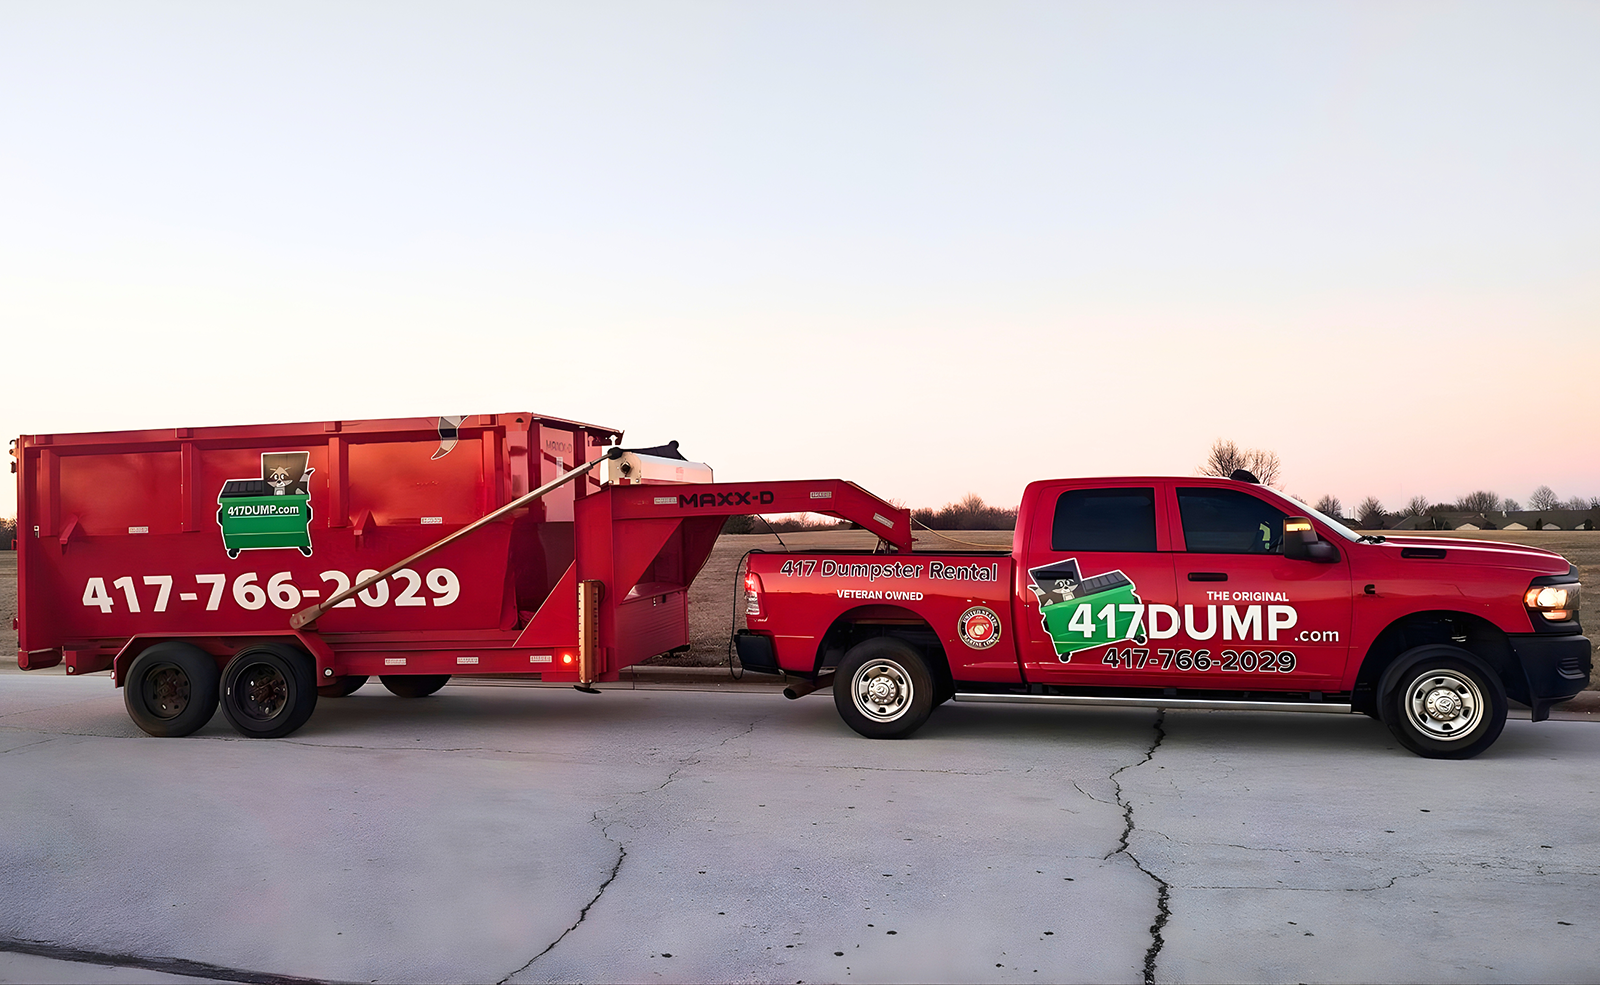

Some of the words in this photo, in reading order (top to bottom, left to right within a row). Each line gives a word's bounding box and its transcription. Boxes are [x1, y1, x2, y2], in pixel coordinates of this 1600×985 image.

[679, 491, 774, 508] MAXX-D
[227, 504, 300, 516] 417DUMP.com
[780, 559, 817, 577] 417
[821, 560, 924, 581] Dumpster
[928, 561, 998, 581] Rental
[82, 567, 461, 613] 417-766-2029
[836, 588, 883, 600] VETERAN
[885, 590, 924, 601] OWNED
[1207, 591, 1230, 601] THE
[1232, 591, 1290, 602] ORIGINAL
[1101, 647, 1297, 674] 417-766-2029
